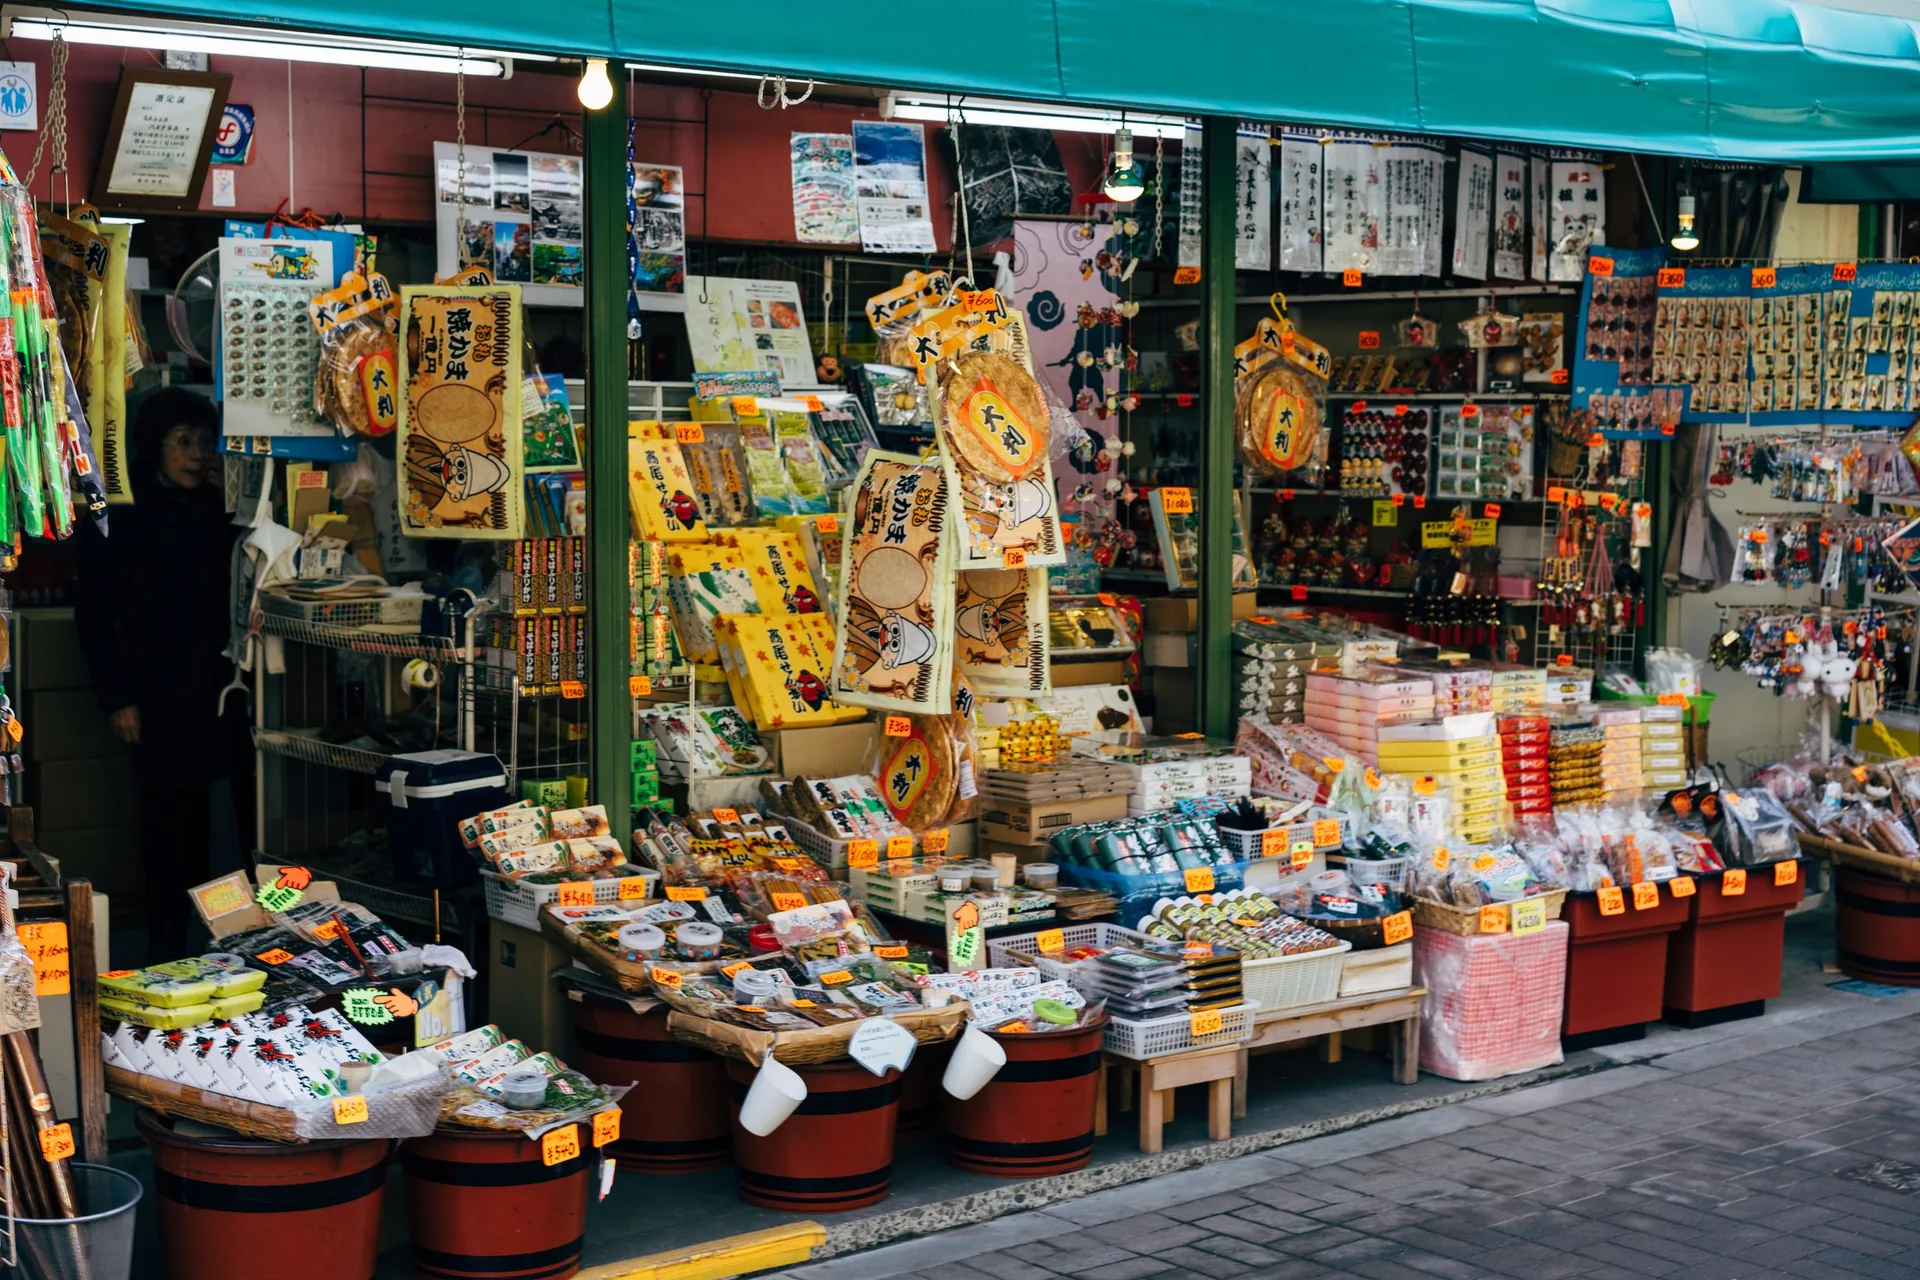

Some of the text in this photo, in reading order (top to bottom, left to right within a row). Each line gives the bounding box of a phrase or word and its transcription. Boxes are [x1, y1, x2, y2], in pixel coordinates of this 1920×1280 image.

[316, 305, 335, 328] 大
[872, 304, 892, 324] 大
[966, 296, 994, 311] ¥600
[915, 336, 939, 364] 大
[1263, 327, 1279, 349] 大
[371, 368, 395, 419] 大判
[980, 403, 1026, 457] 大判
[1274, 406, 1294, 454] 大判
[892, 752, 922, 803] 大判
